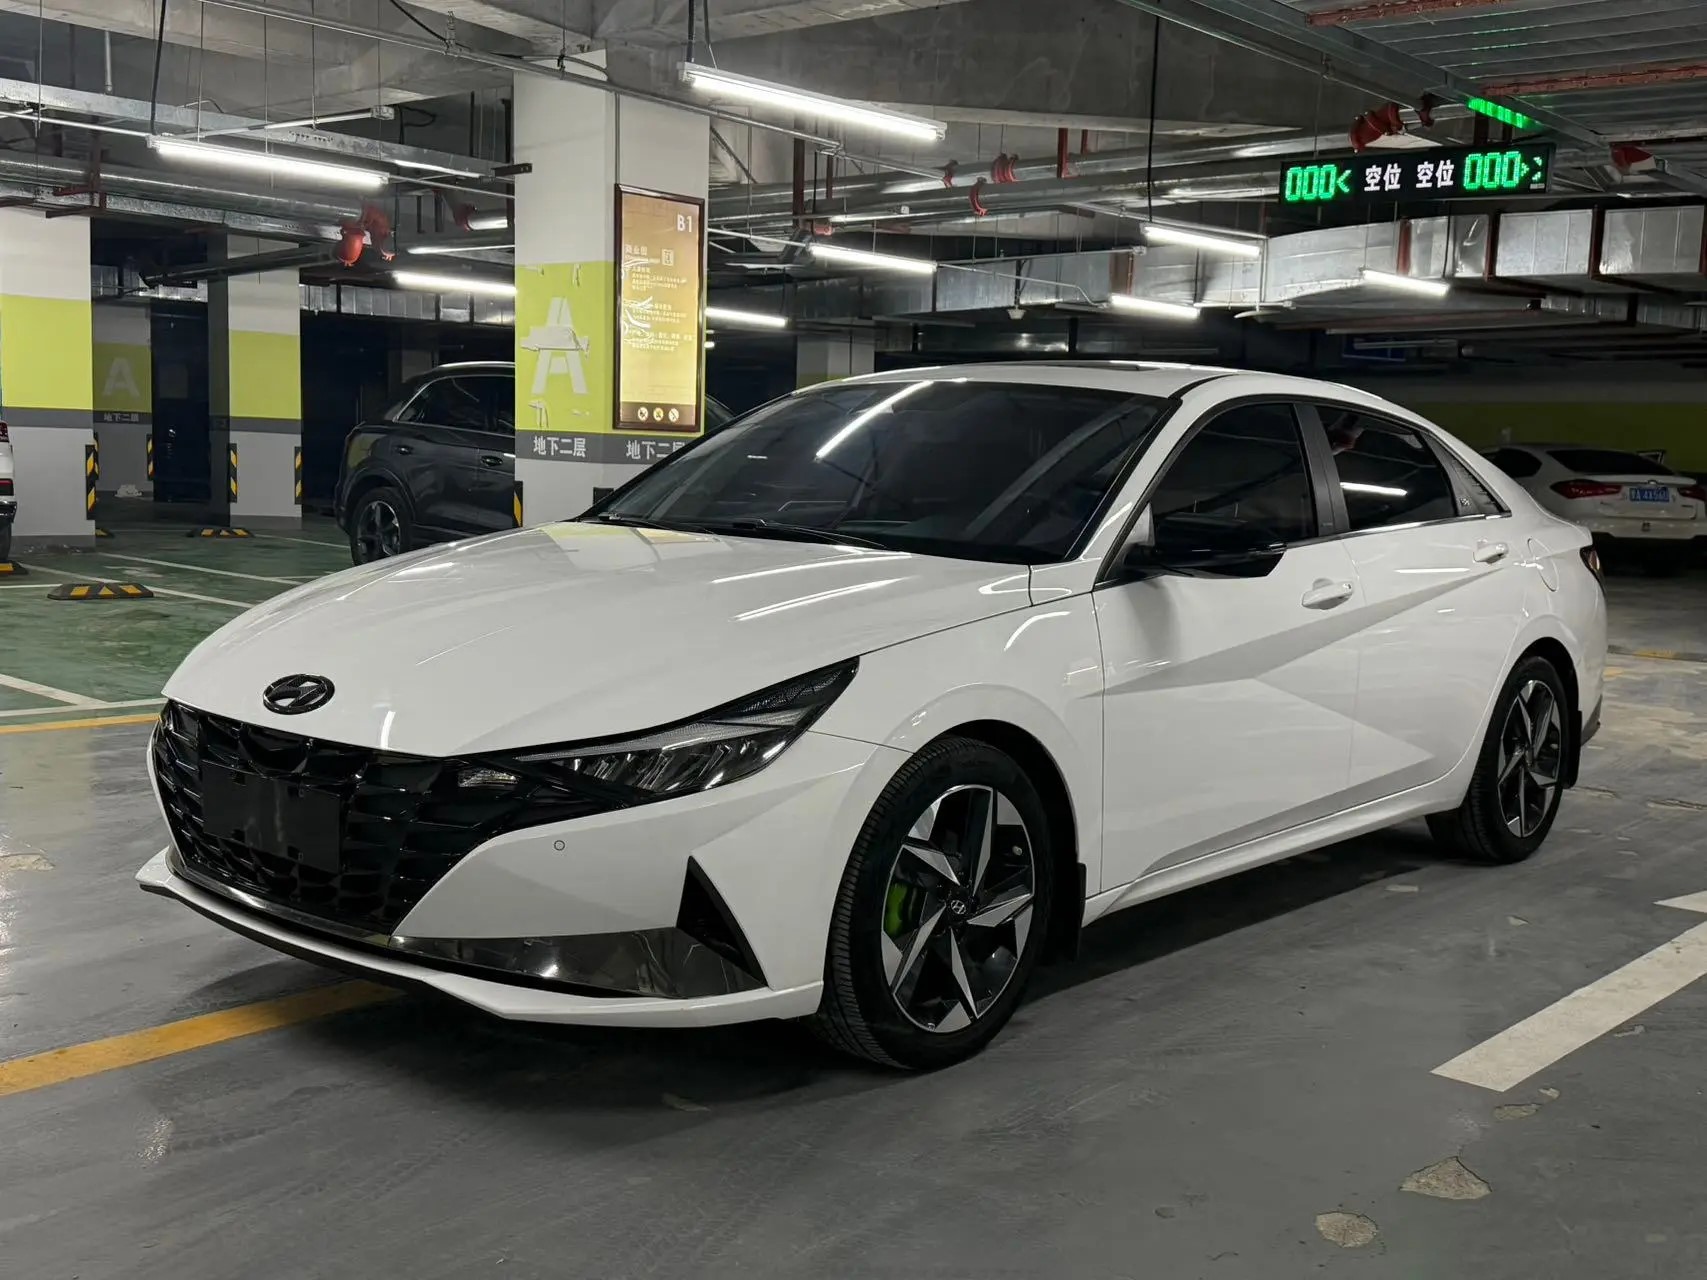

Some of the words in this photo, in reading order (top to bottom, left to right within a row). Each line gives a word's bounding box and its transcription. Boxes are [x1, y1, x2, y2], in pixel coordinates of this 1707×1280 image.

[1364, 163, 1402, 191] 空位
[1416, 160, 1455, 188] 空位
[677, 214, 692, 233] B1
[531, 297, 590, 394] A
[102, 357, 140, 397] A
[533, 436, 586, 458] 地下二层
